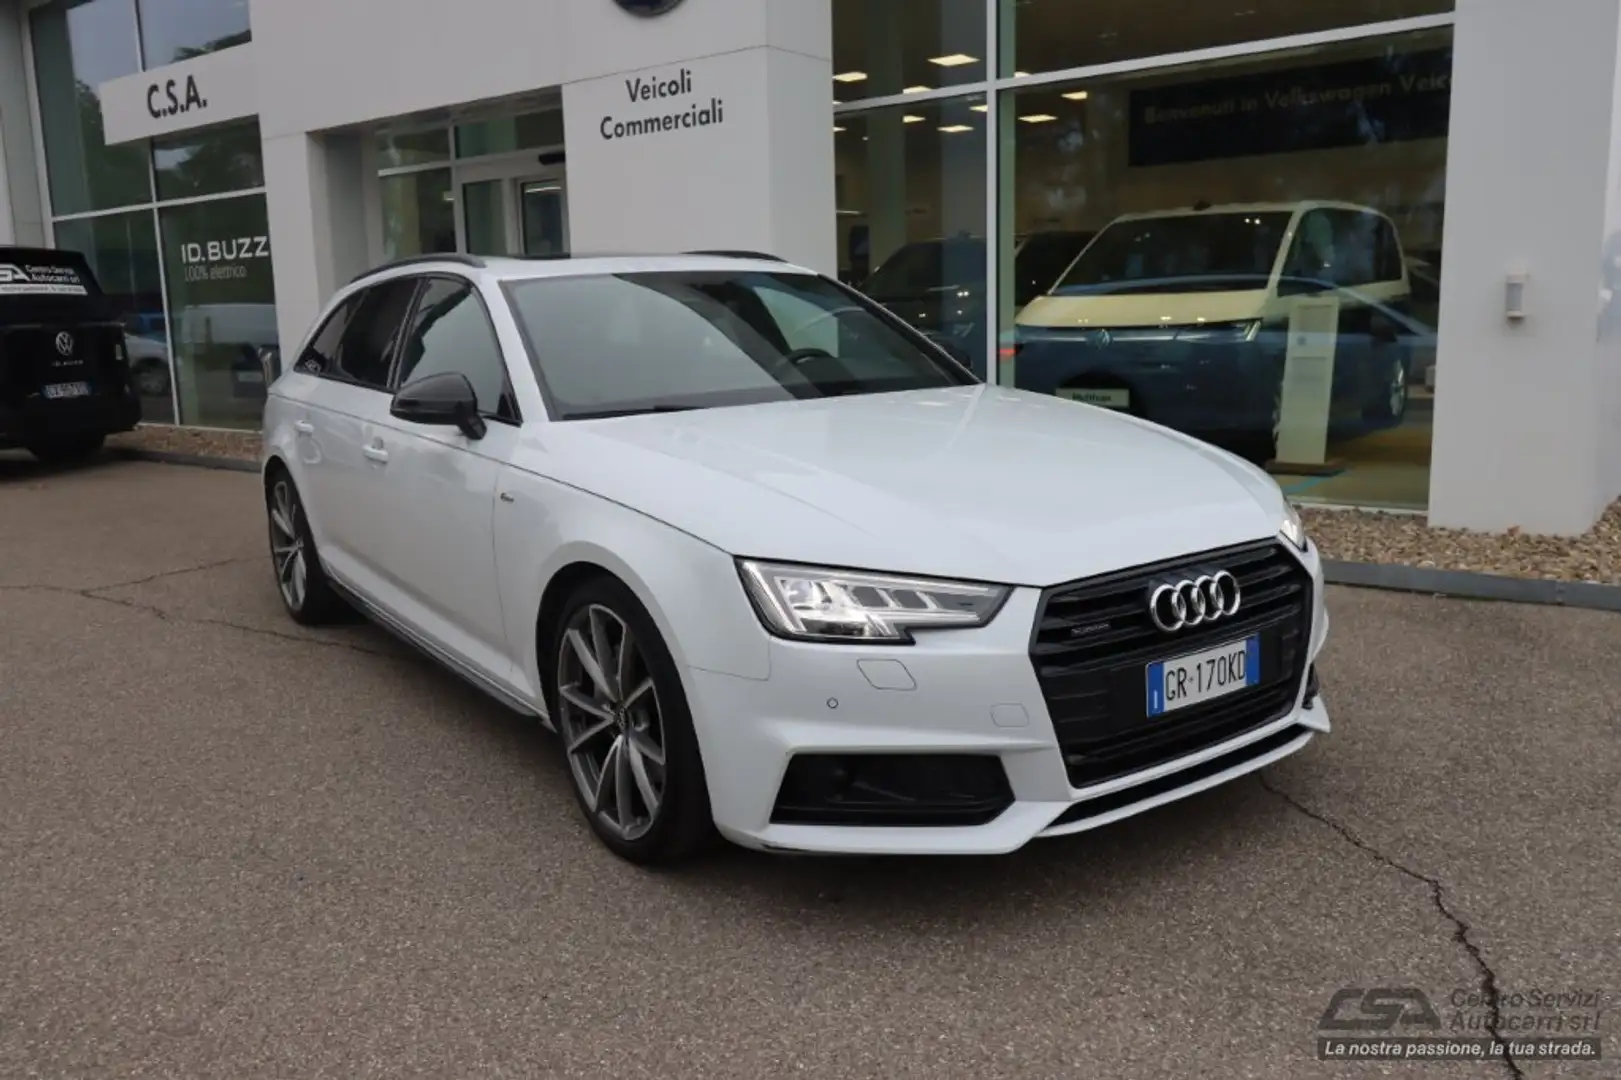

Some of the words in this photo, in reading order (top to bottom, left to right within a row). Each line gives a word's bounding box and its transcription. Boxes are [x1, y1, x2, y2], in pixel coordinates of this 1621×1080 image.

[147, 75, 208, 118] C.S.A.
[625, 68, 692, 102] Veicoli
[1264, 82, 1392, 110] Volkswagen
[1398, 73, 1451, 93] Veic
[600, 97, 724, 140] Commerciali
[180, 235, 269, 264] ID.BUZZ
[184, 264, 209, 282] 100%
